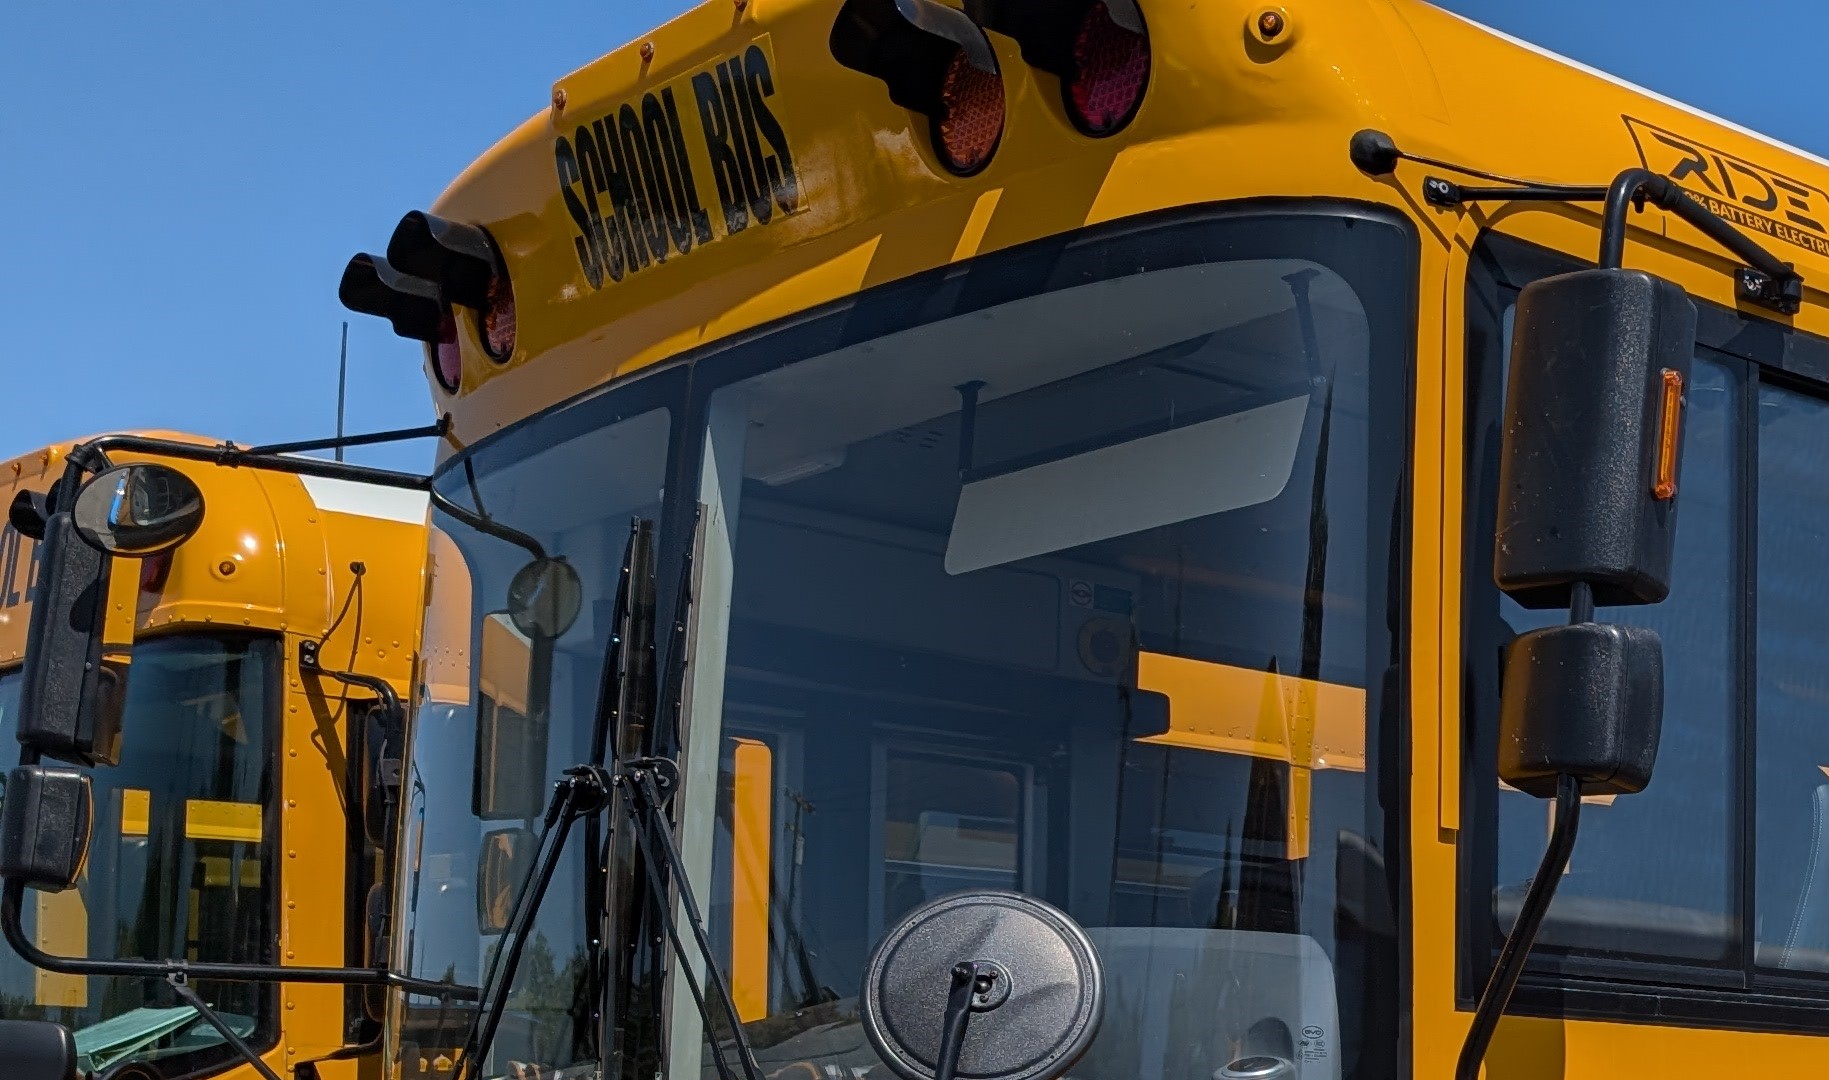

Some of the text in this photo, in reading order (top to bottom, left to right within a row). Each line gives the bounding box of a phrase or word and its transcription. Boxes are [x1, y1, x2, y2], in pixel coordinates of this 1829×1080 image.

[555, 45, 799, 291] SCHOOL BUS
[1650, 130, 1828, 235] RIDE
[1709, 199, 1772, 234] BATTERY
